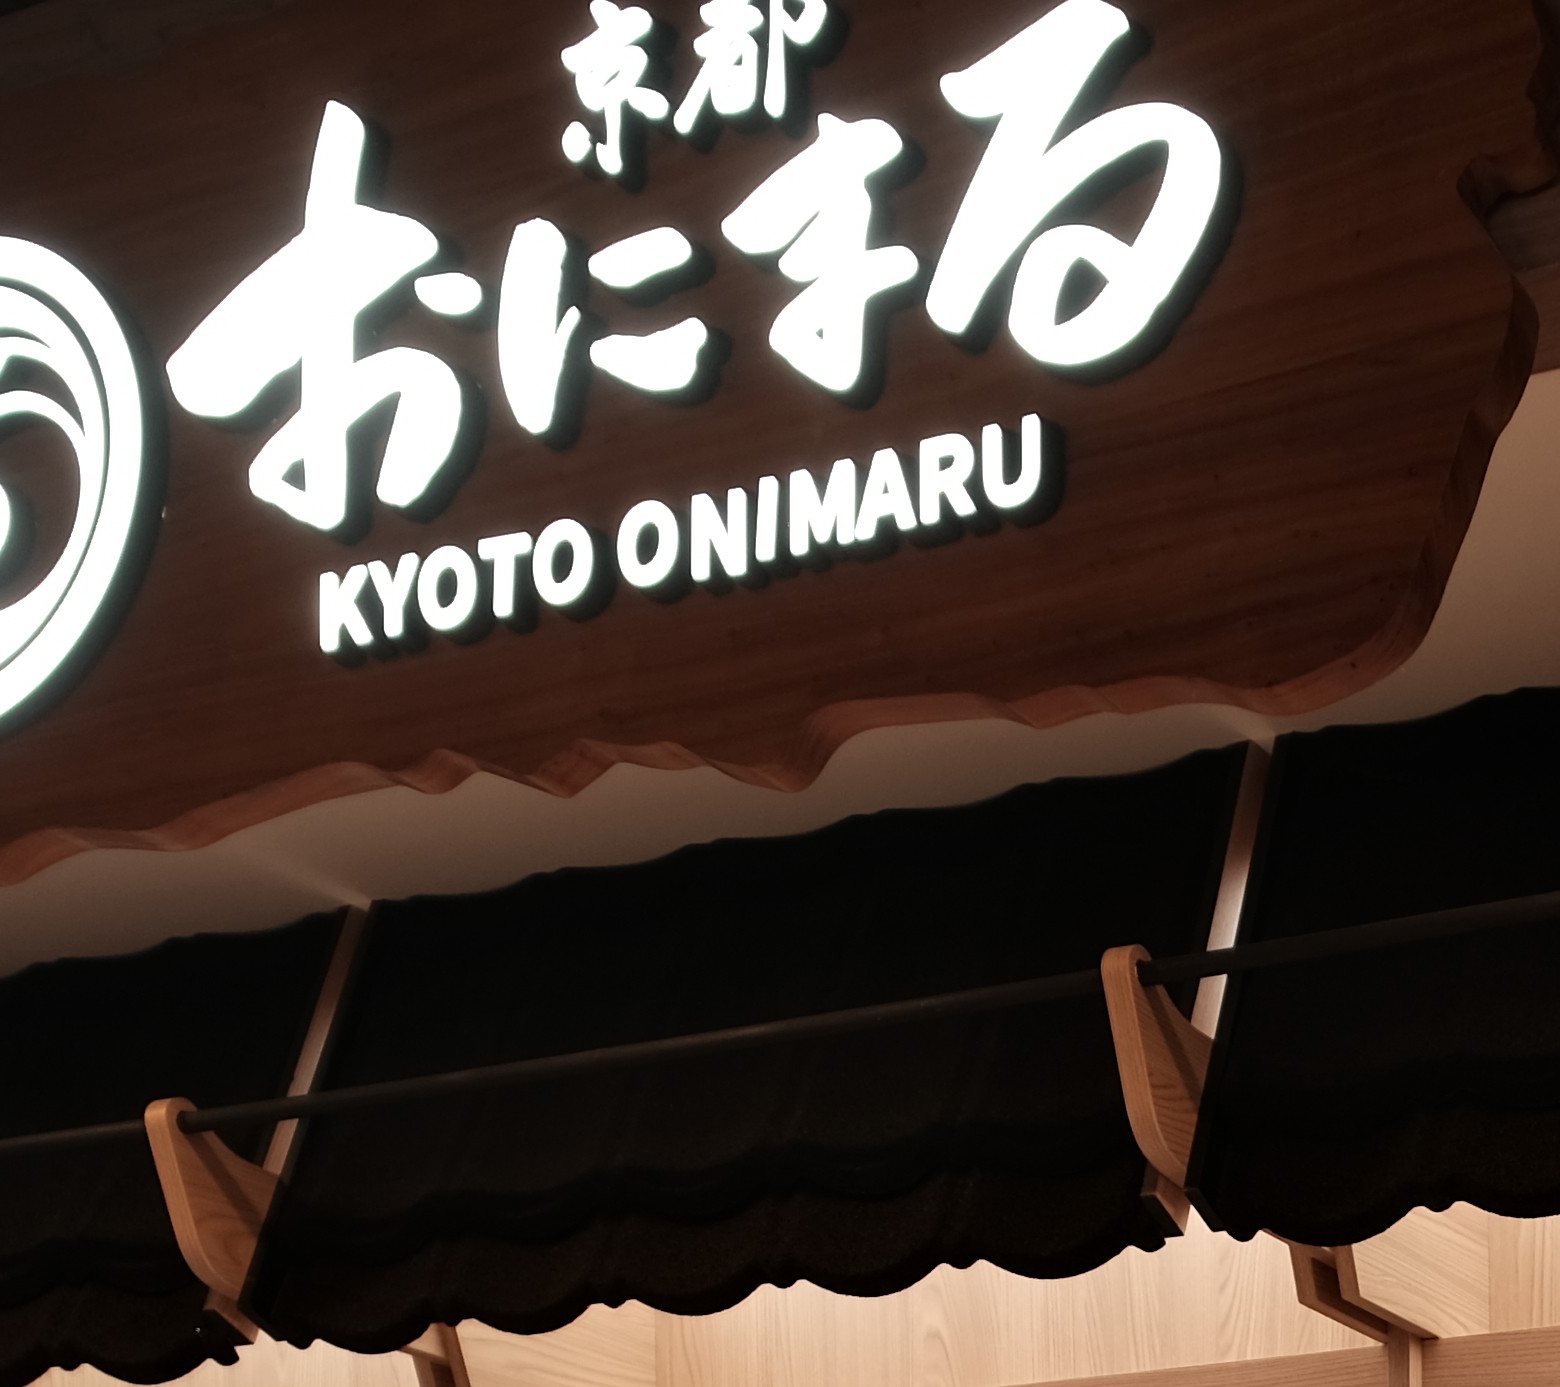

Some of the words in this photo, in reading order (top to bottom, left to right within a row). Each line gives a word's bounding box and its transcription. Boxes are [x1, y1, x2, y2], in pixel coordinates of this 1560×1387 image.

[560, 0, 827, 175] 京都
[167, 0, 1222, 530] おにまる
[318, 530, 594, 655] KYOTO
[617, 413, 1043, 588] ONIMARU
